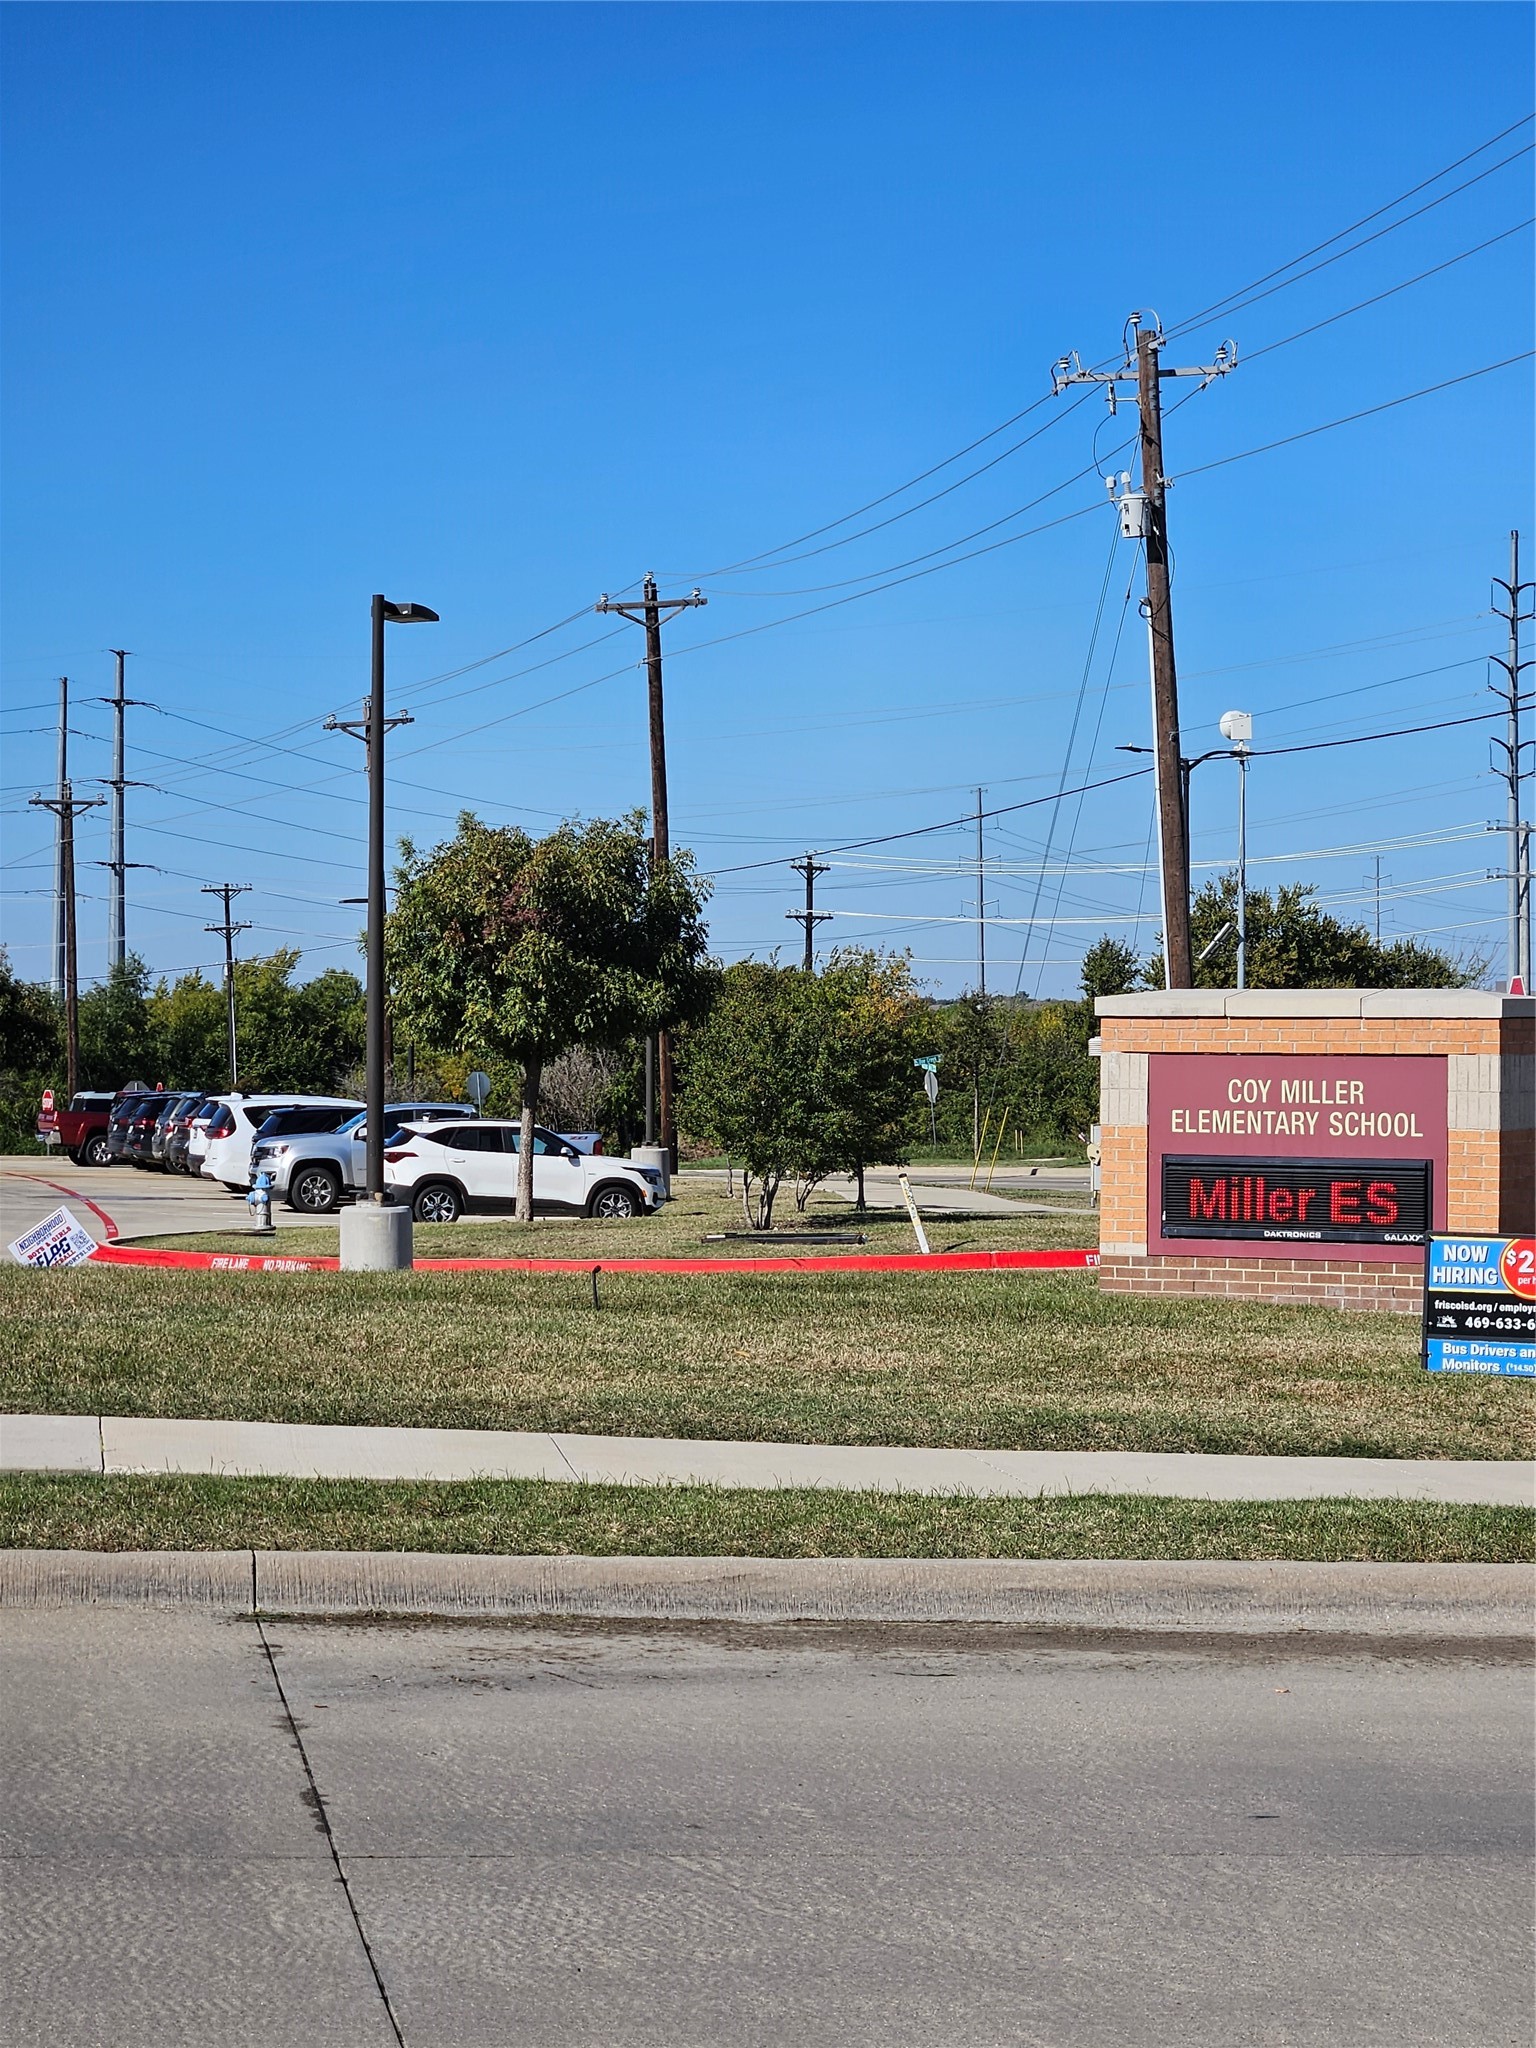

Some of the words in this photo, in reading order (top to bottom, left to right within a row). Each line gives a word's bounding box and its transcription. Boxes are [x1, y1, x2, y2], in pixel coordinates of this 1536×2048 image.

[1227, 1079, 1272, 1103] COY
[1281, 1080, 1364, 1104] MILLER
[1171, 1109, 1319, 1135] ELEMENTARY
[1329, 1112, 1424, 1137] SCHOOL
[1190, 1177, 1315, 1221] Miller
[1330, 1181, 1398, 1224] ES
[19, 1213, 63, 1252] NEIGHBORHOOD
[1263, 1230, 1322, 1239] DAKTRONICS
[1384, 1234, 1423, 1242] GALAXY
[27, 1246, 46, 1261] BOYS
[51, 1226, 72, 1244] GIRLS
[35, 1236, 71, 1267] FLAG
[1443, 1244, 1489, 1263] NOW
[211, 1258, 229, 1269] FIRE
[228, 1258, 249, 1270] LANE
[263, 1260, 275, 1271] NO
[1432, 1266, 1499, 1285] HIRING
[1517, 1277, 1531, 1286] per
[1442, 1342, 1467, 1355] Bus
[1470, 1344, 1517, 1358] Drivers
[1442, 1358, 1501, 1373] Monitors
